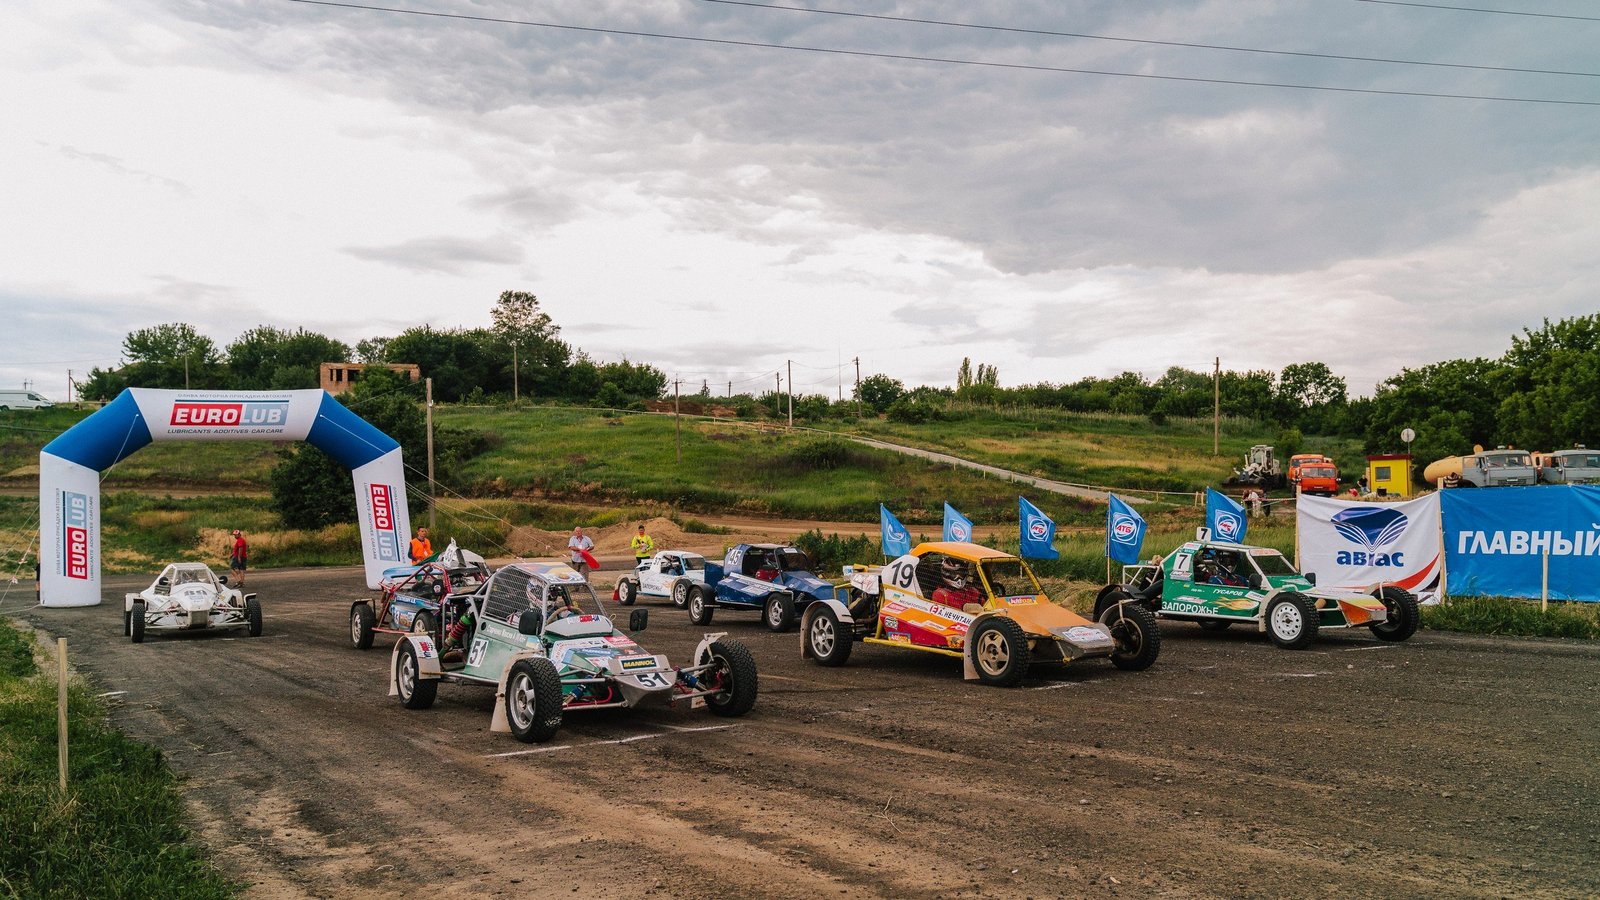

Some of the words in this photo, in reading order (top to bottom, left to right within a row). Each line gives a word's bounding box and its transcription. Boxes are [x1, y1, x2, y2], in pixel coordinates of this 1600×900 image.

[1200, 528, 1208, 539] 7
[1458, 523, 1600, 555] ГЛАВНЫЙ
[730, 549, 742, 565] 45
[1178, 554, 1188, 569] 7
[892, 561, 914, 588] 19
[1162, 601, 1218, 614] ЗАПОРОЖЬЕ
[469, 639, 487, 666] 51
[623, 658, 655, 669] MANNOL
[637, 673, 669, 687] 51
